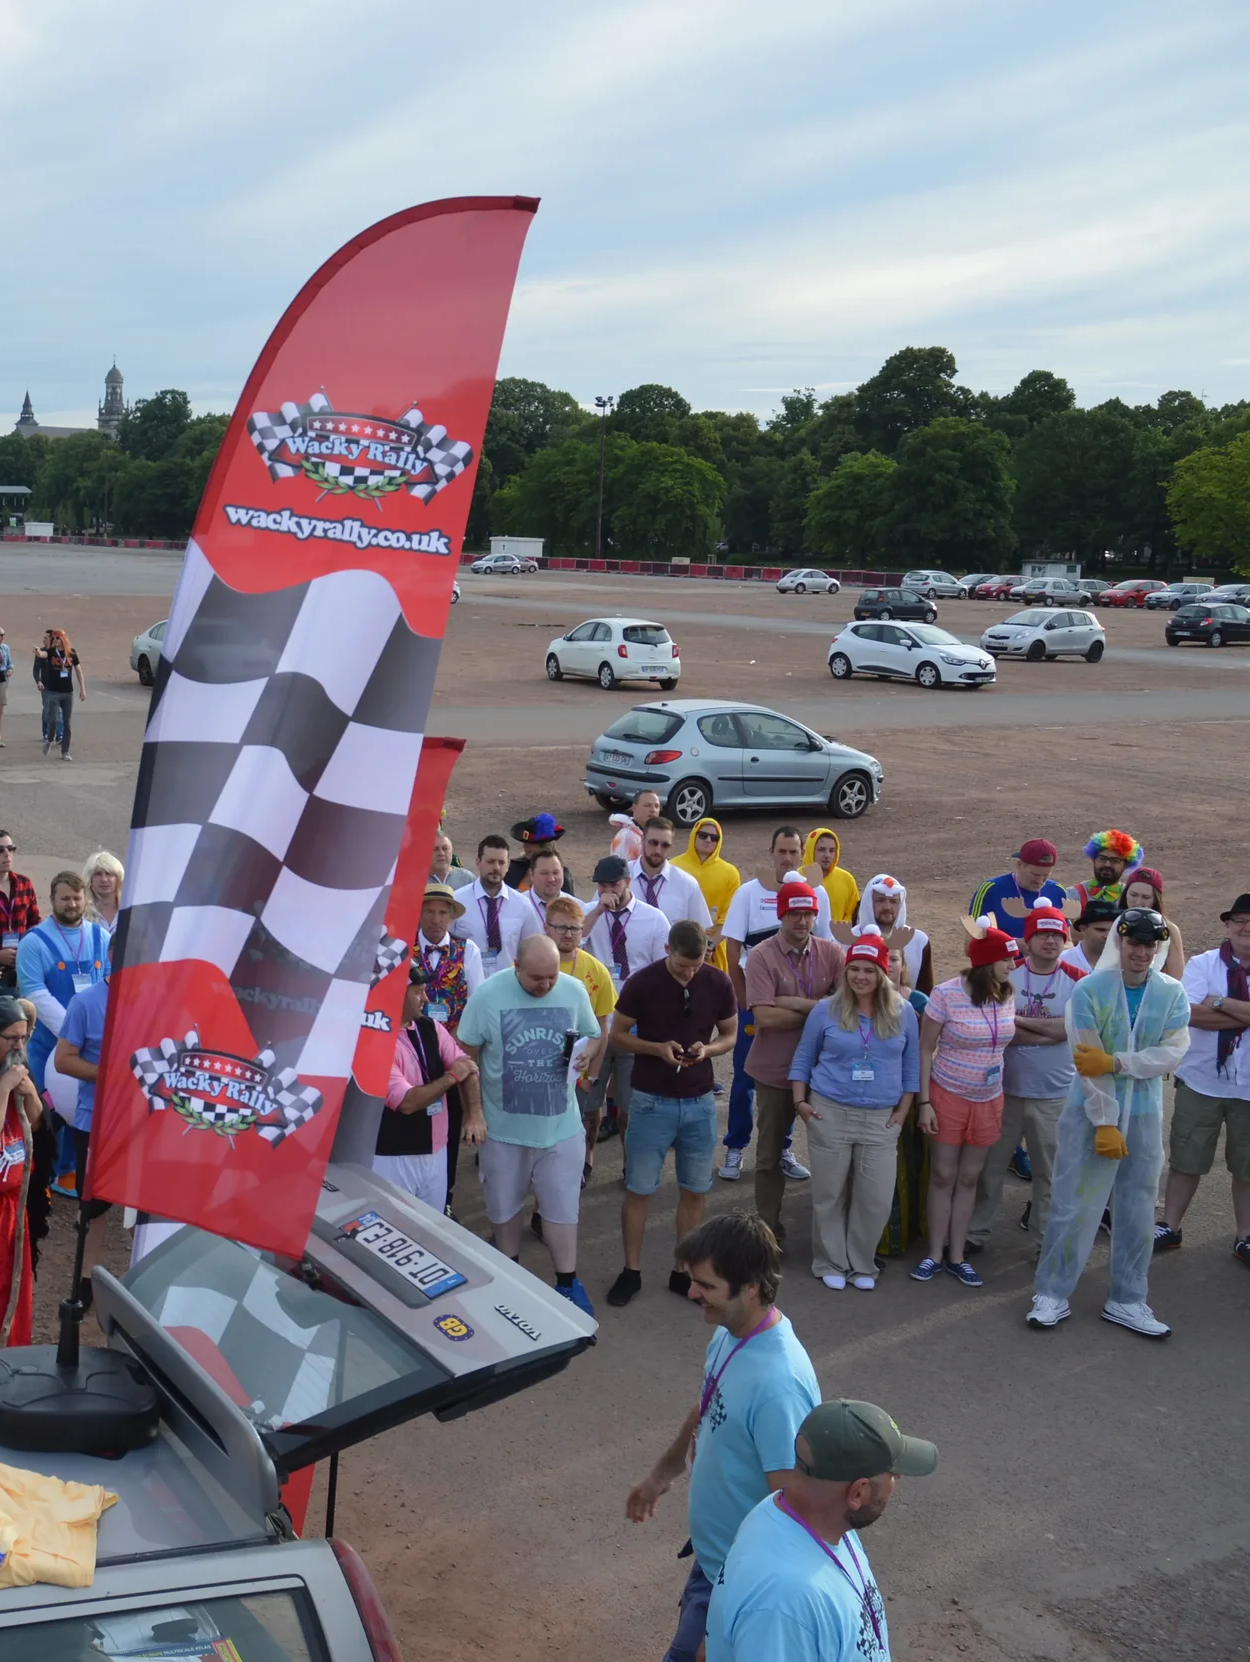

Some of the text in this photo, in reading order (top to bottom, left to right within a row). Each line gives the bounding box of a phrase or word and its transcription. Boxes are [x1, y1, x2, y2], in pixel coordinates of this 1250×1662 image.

[285, 433, 428, 475] Wacky Rally
[224, 504, 451, 556] wackyrally.co.uk
[527, 1059, 553, 1067] THE
[162, 1070, 279, 1116] Wacky Rally
[439, 1317, 468, 1337] GB
[494, 1304, 542, 1341] VOLVO
